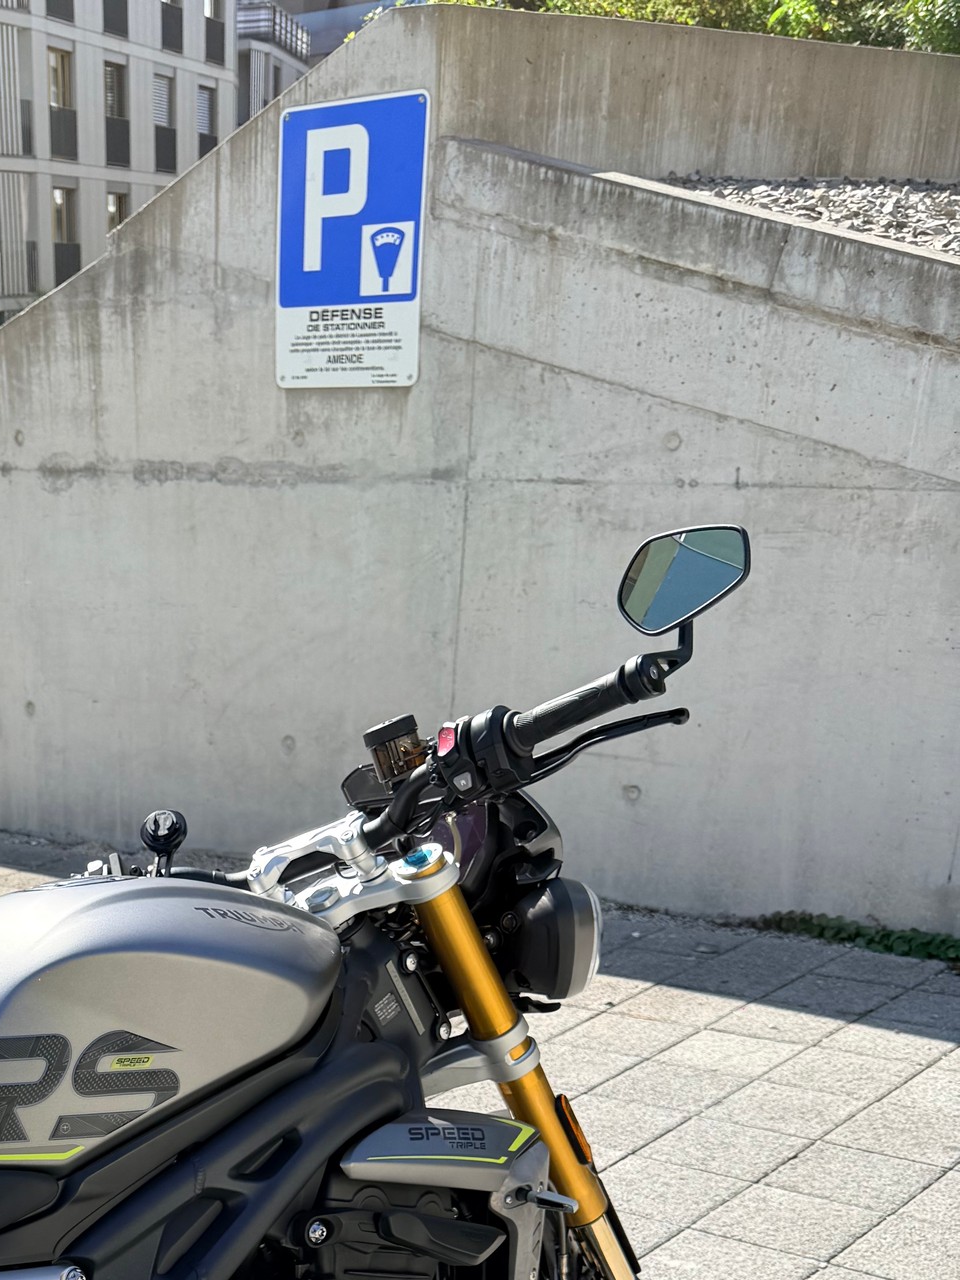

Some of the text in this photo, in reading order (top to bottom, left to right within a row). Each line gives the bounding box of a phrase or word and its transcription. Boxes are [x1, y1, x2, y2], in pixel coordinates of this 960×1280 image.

[303, 124, 369, 272] P
[307, 322, 385, 332] DE STATIONNER
[326, 354, 364, 364] AMENDE
[194, 907, 305, 935] TRIUMPH
[115, 1056, 150, 1065] SPEED
[408, 1127, 485, 1141] SPEED
[449, 1141, 486, 1150] TRIPLE
